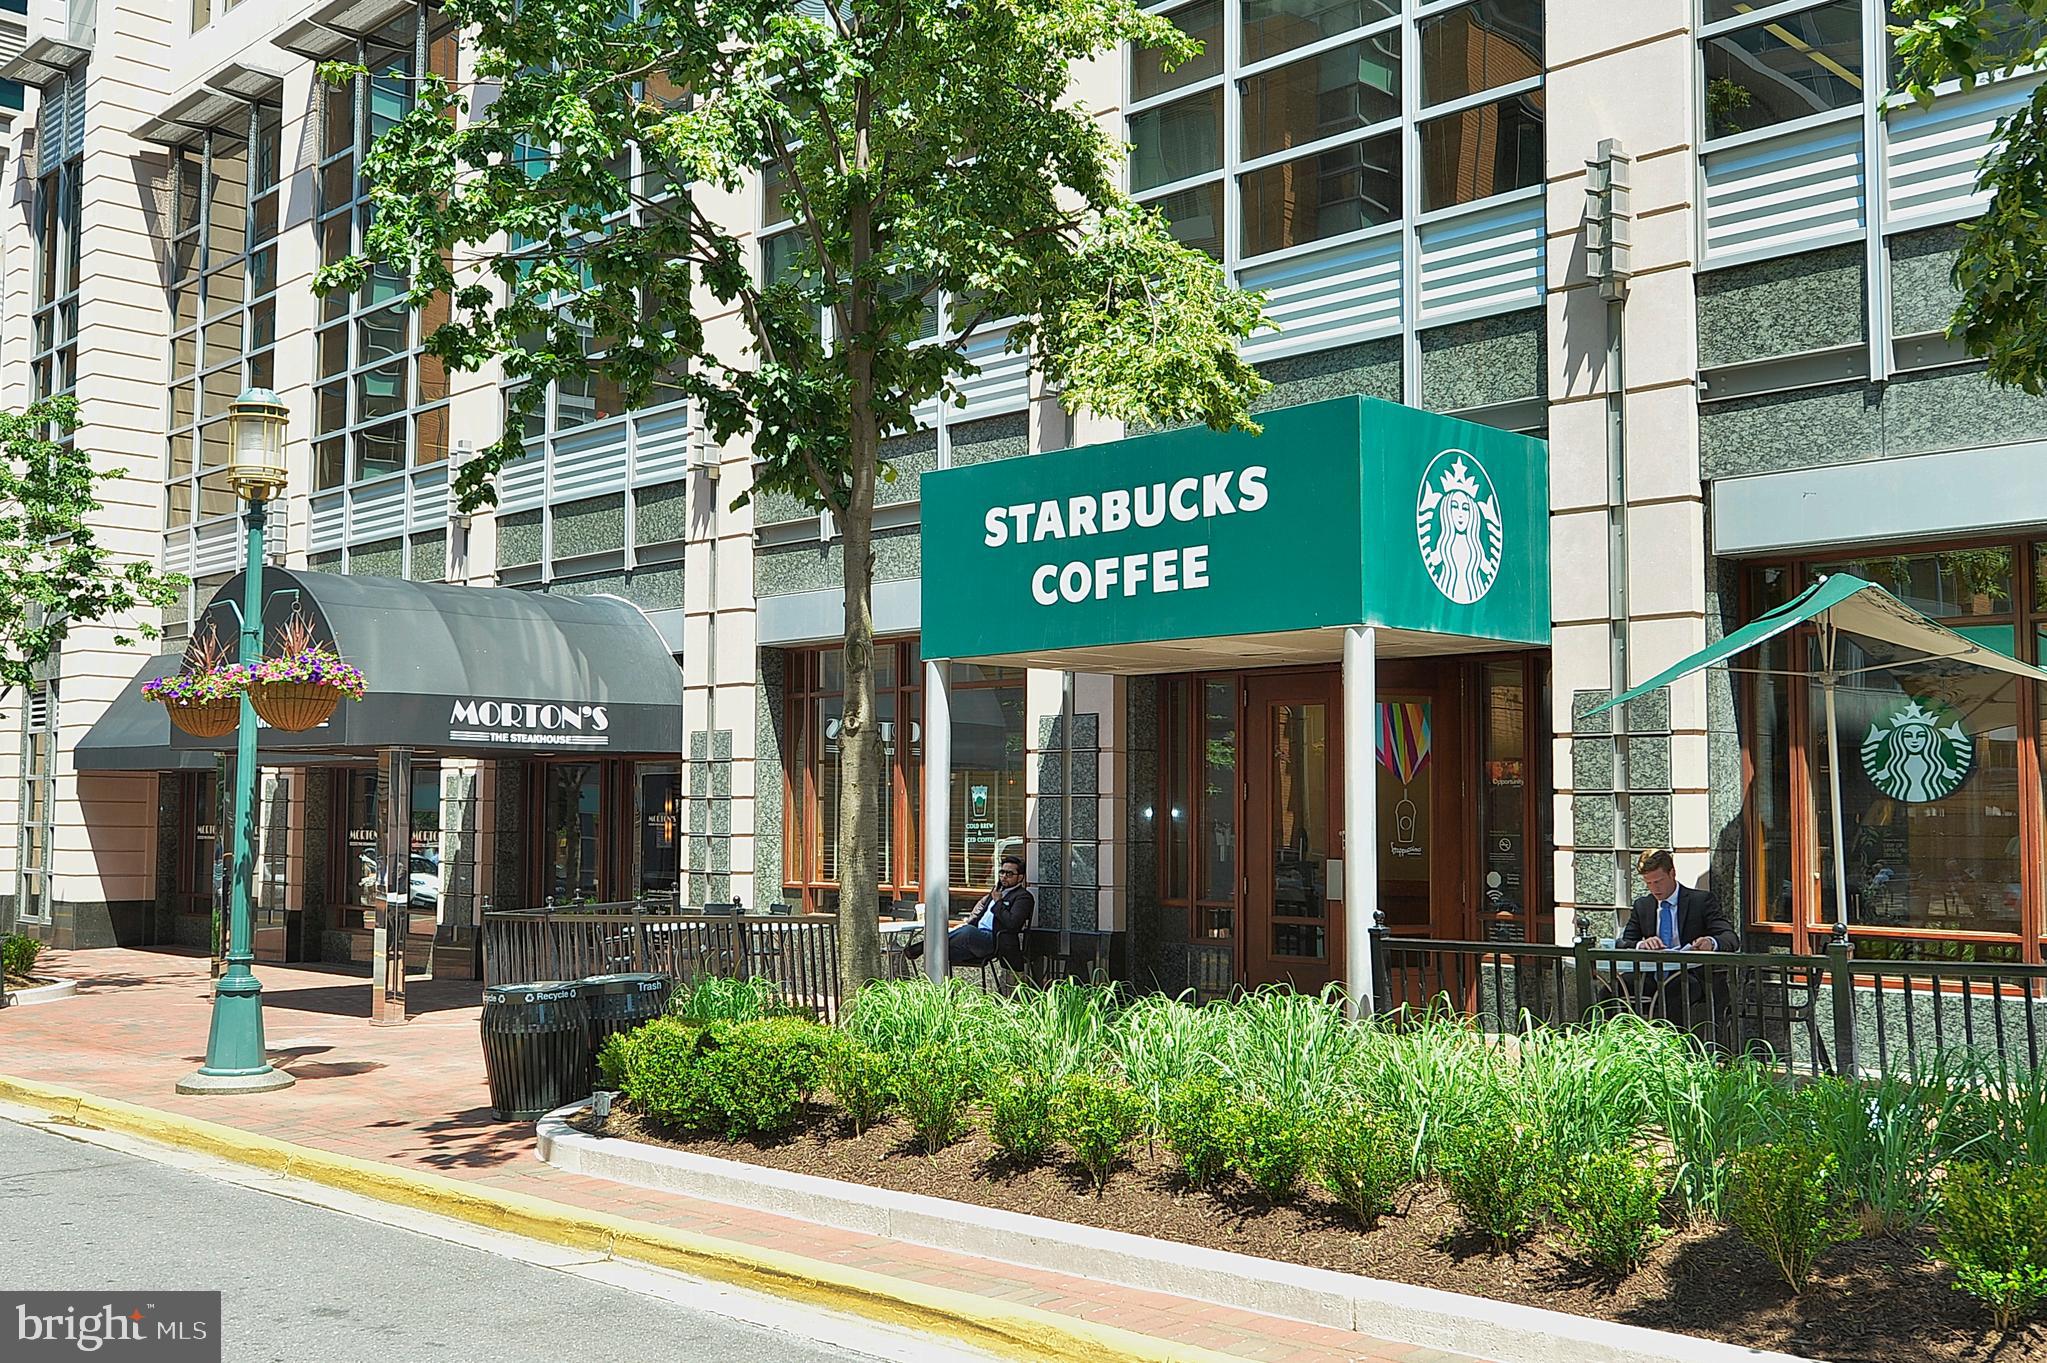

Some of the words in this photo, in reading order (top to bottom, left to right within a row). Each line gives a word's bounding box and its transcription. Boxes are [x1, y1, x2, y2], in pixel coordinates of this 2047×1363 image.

[984, 465, 1269, 547] STARBUCKS
[1031, 544, 1210, 606] COFFEE
[450, 699, 609, 731] MORTON'S
[490, 732, 509, 743] THE
[510, 733, 572, 745] STEAKHOUSE
[536, 989, 569, 1002] Recycle
[636, 980, 662, 993] Trash
